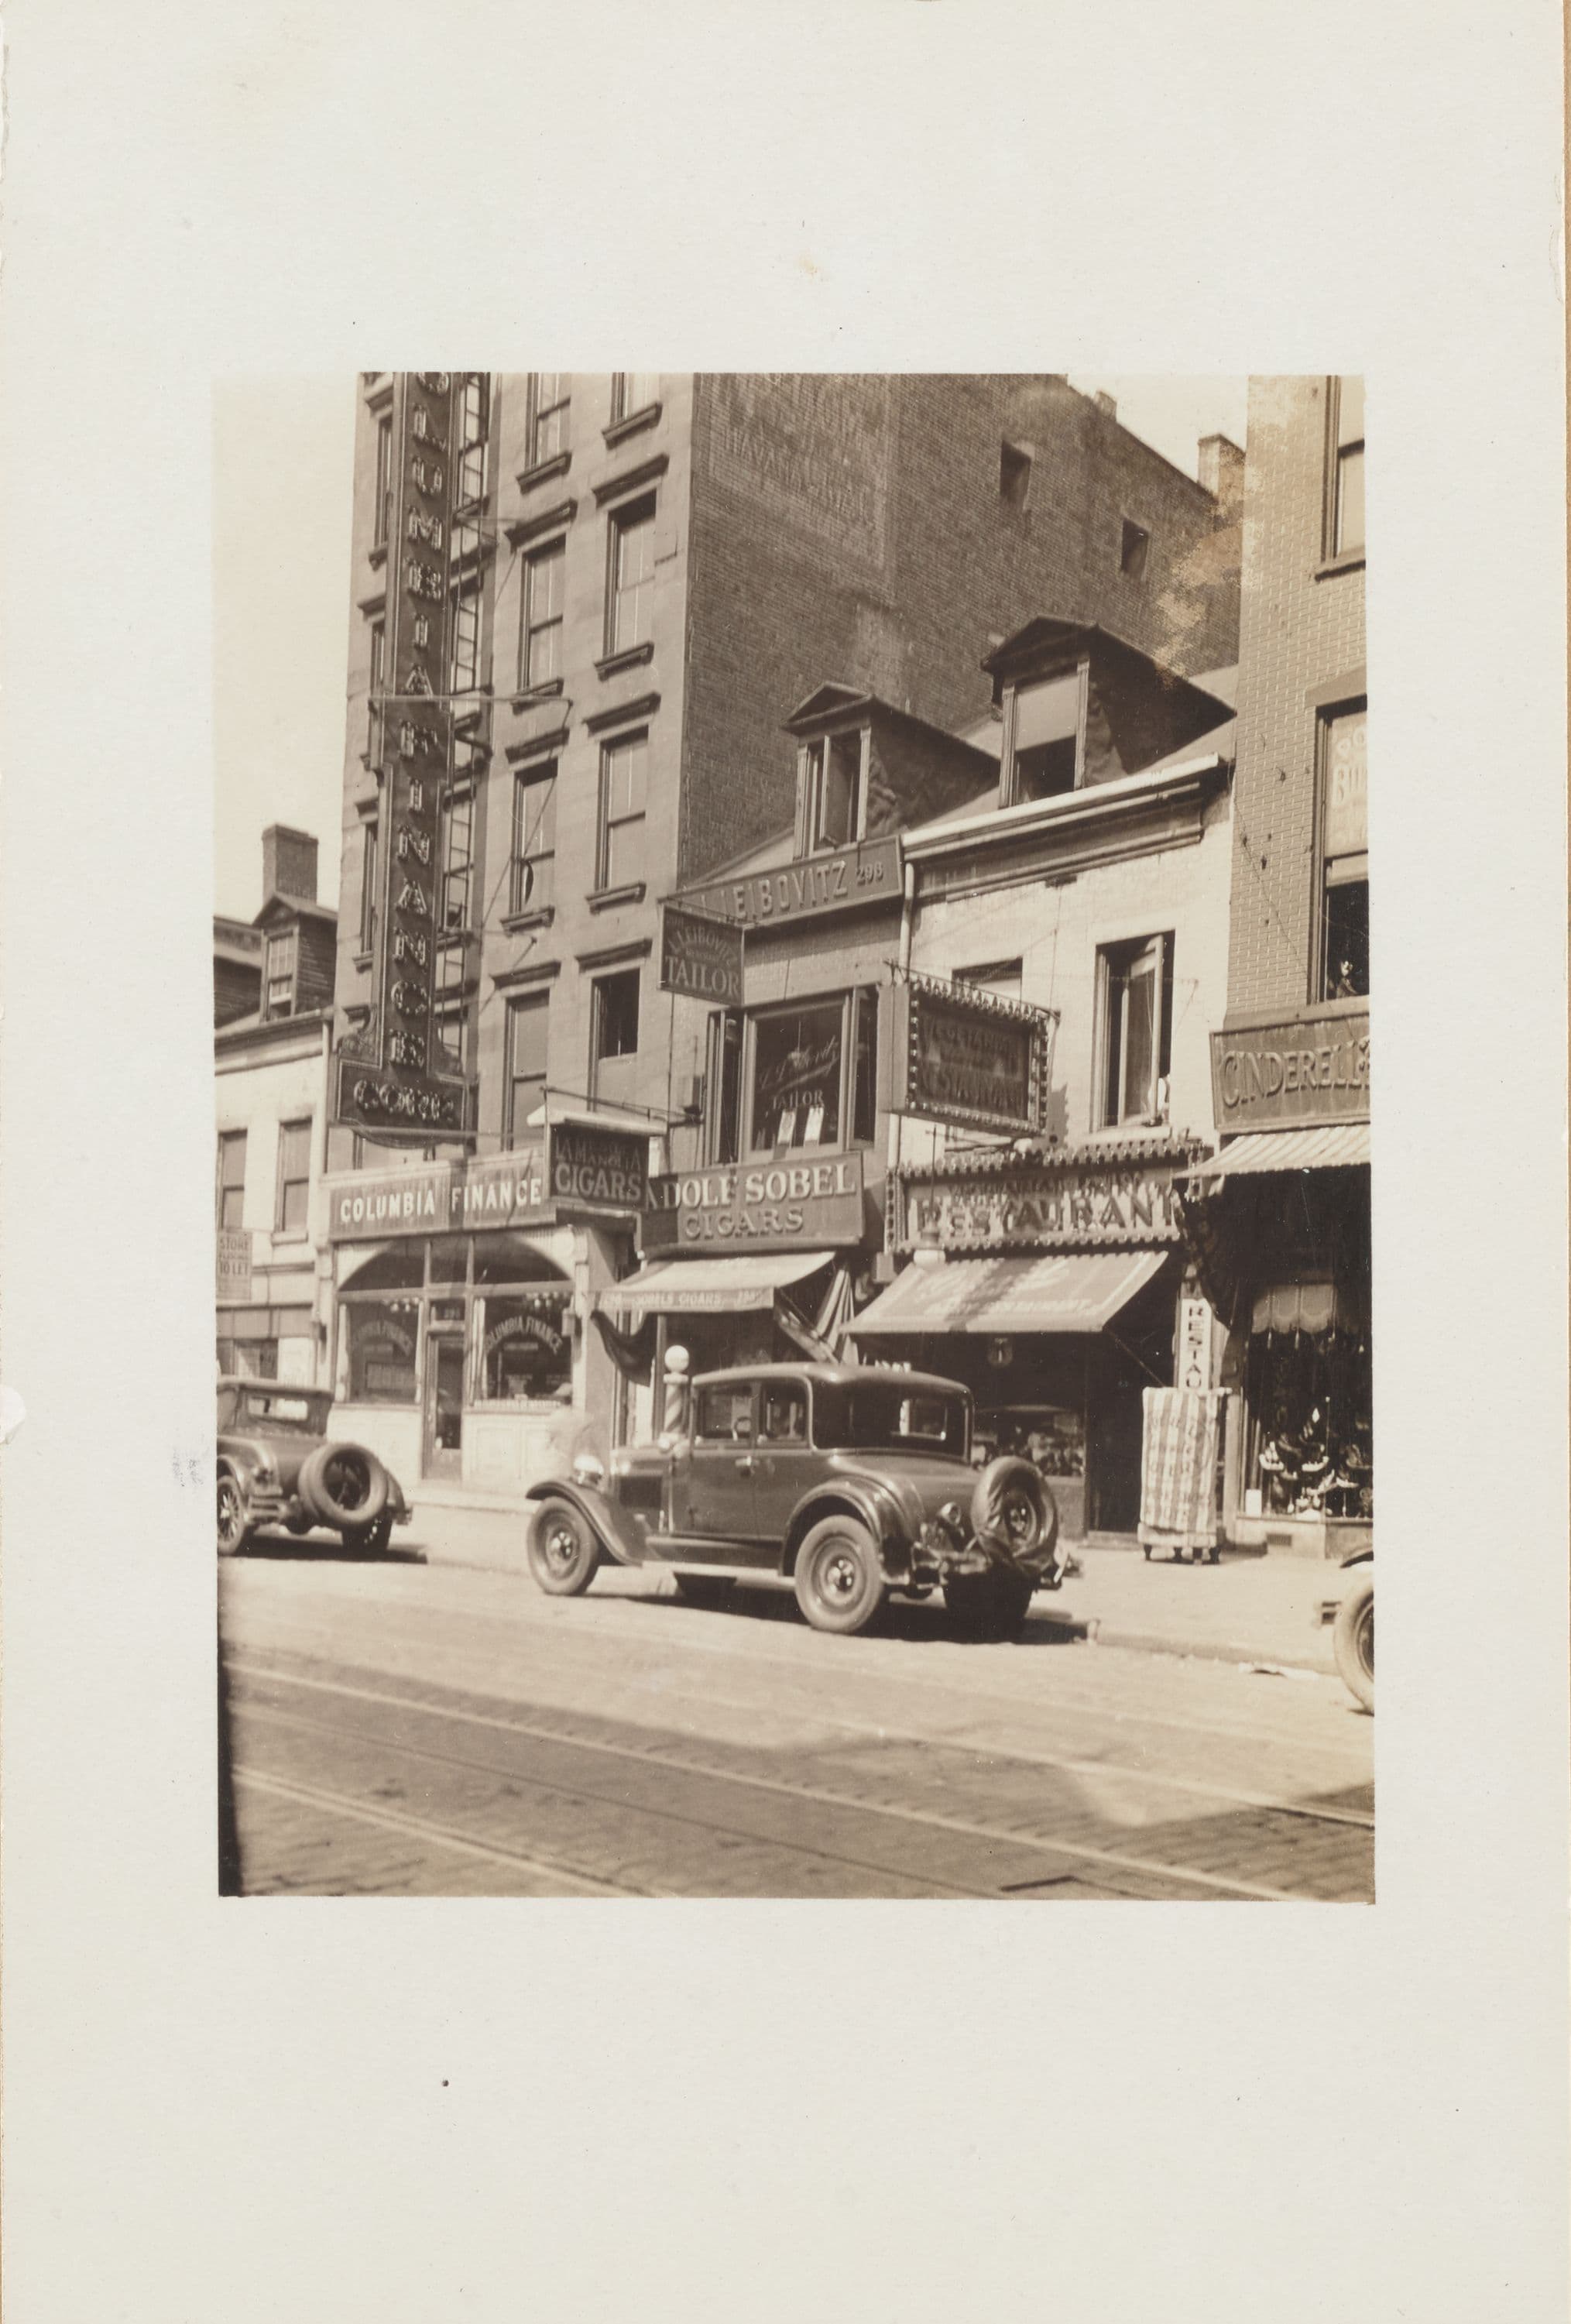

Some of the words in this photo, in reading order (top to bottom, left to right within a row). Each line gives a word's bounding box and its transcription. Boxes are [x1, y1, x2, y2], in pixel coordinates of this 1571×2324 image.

[664, 955, 740, 1000] TAILOR
[339, 1188, 437, 1224] COLUMBIA
[451, 1177, 544, 1213] FINANCE
[555, 1162, 642, 1203] CIGARS
[744, 1163, 856, 1206] SOBEL
[684, 1206, 804, 1239] CIGARS
[219, 1237, 249, 1251] STORE
